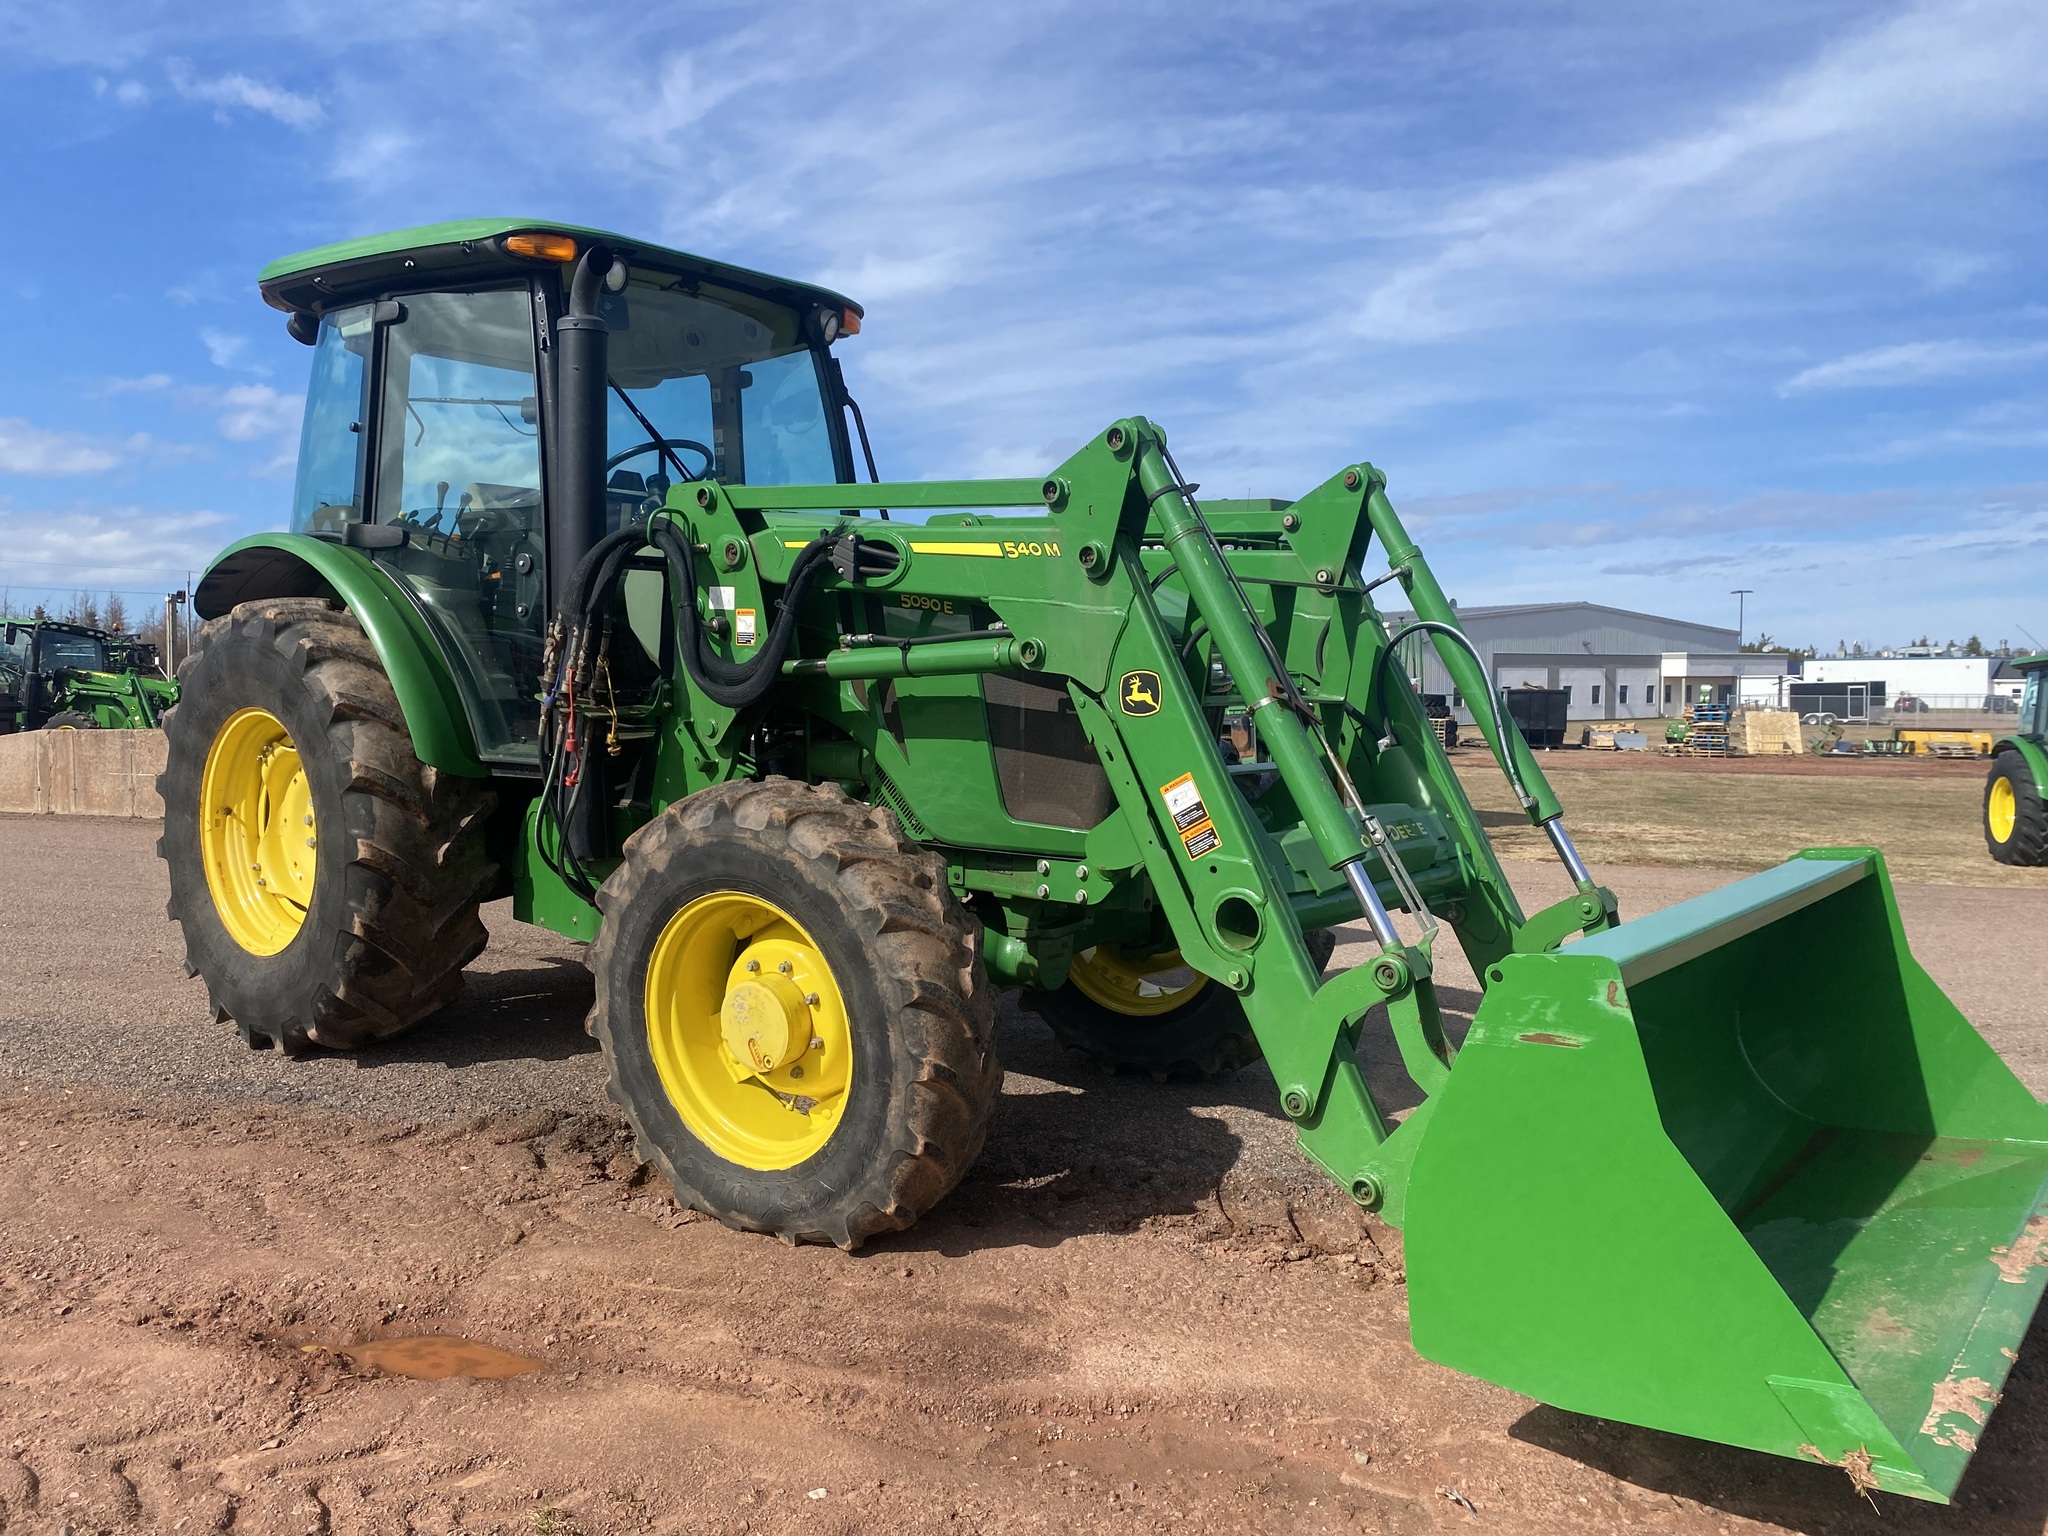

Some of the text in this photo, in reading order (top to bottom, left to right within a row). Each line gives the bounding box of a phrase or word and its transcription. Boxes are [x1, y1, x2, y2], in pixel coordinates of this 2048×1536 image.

[1003, 541, 1062, 559] 540 M
[901, 594, 954, 614] 5090 E
[1385, 822, 1428, 841] DEEE
